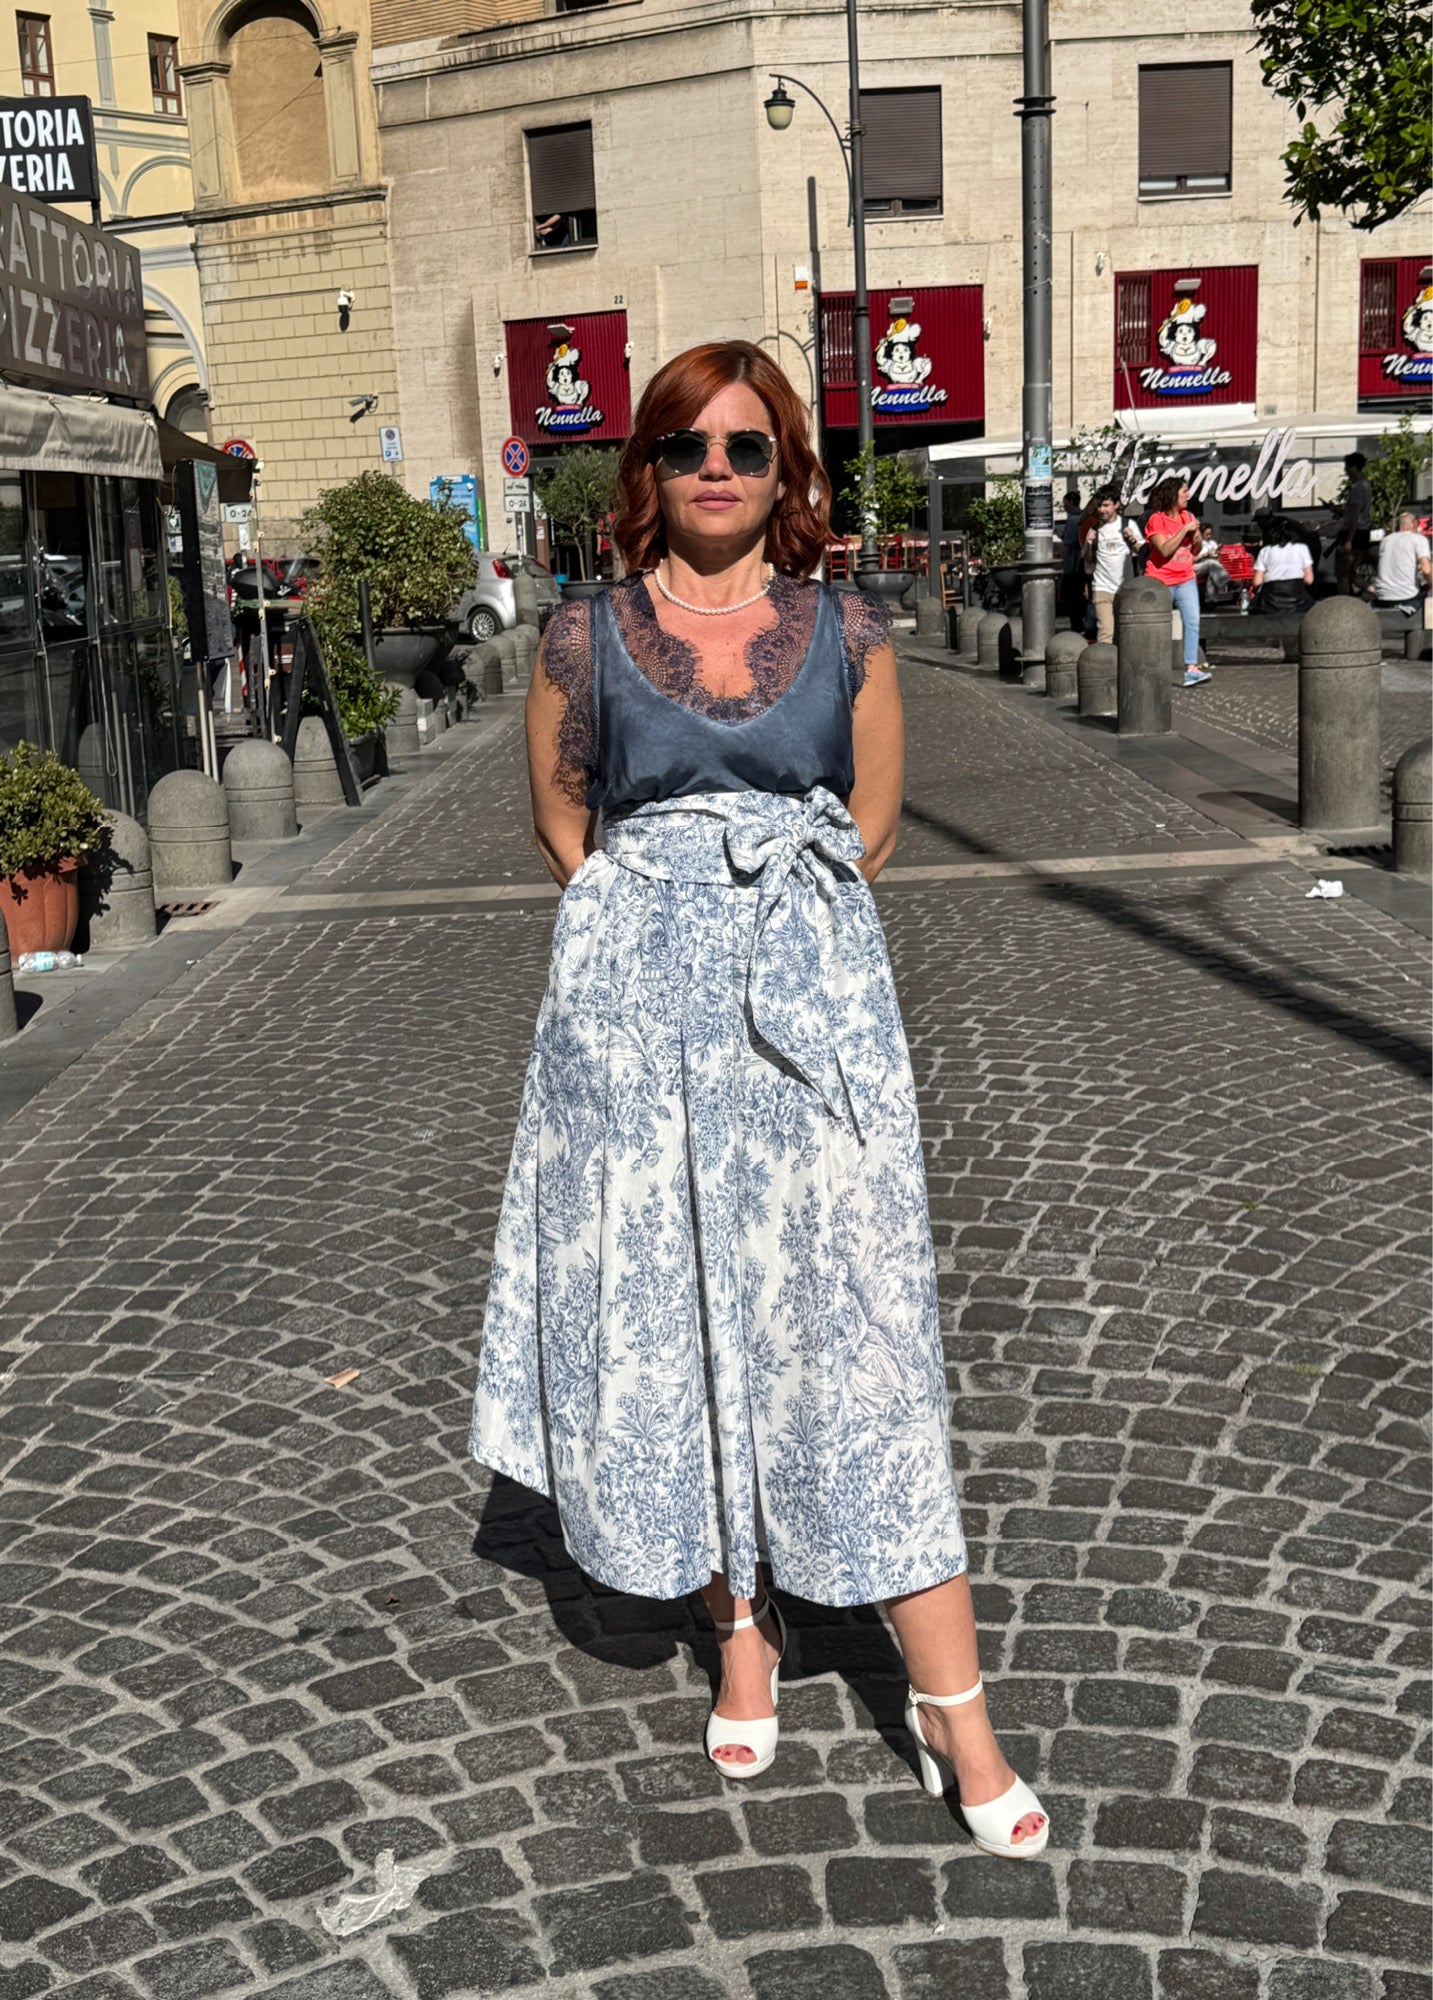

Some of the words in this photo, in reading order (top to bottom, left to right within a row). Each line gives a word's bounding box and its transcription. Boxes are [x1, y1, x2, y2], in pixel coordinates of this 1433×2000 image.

[0, 202, 140, 317] ATTORIA
[613, 294, 624, 305] 22
[0, 284, 131, 387] IZZERIA
[1139, 366, 1233, 390] Nennella
[535, 405, 603, 426] Nennella
